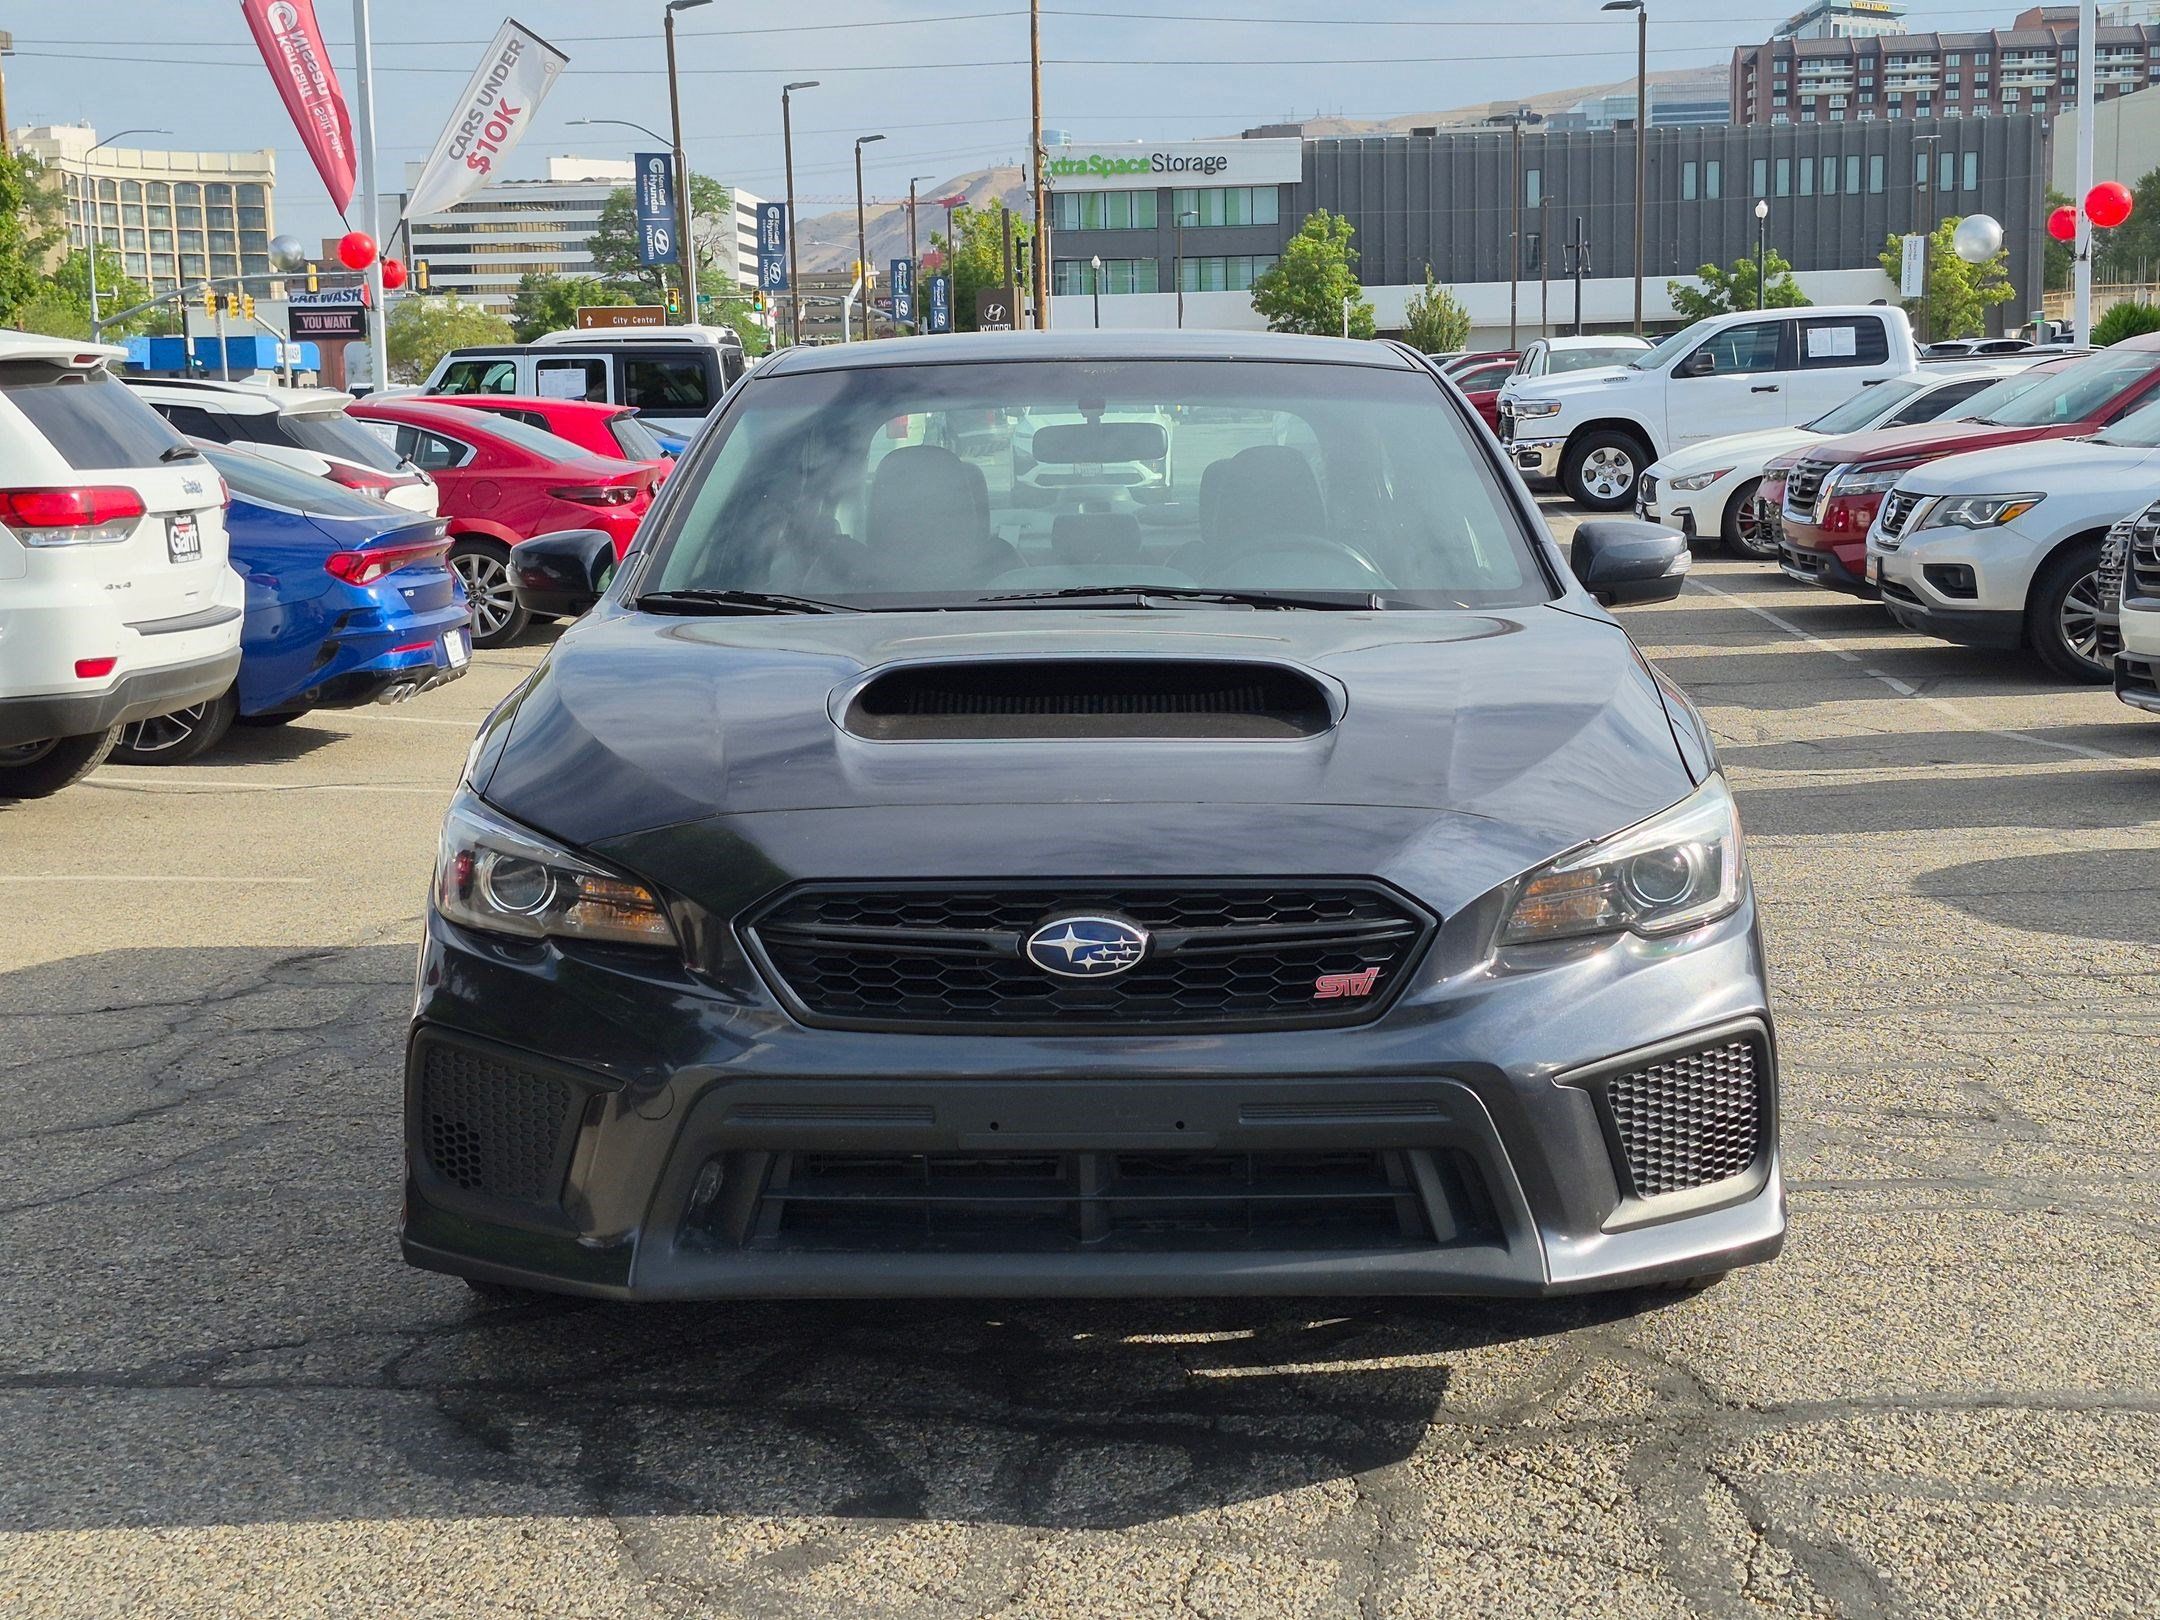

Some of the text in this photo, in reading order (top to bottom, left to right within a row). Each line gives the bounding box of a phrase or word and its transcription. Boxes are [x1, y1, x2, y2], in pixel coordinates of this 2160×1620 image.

[449, 39, 525, 160] CARS UNDER
[466, 97, 522, 175] $10K
[1151, 153, 1227, 175] Storage
[648, 174, 660, 214] Hyundai
[321, 288, 362, 304] WASH
[302, 315, 352, 329] YOU WANT
[613, 316, 657, 325] City Center
[170, 523, 199, 554] Garff
